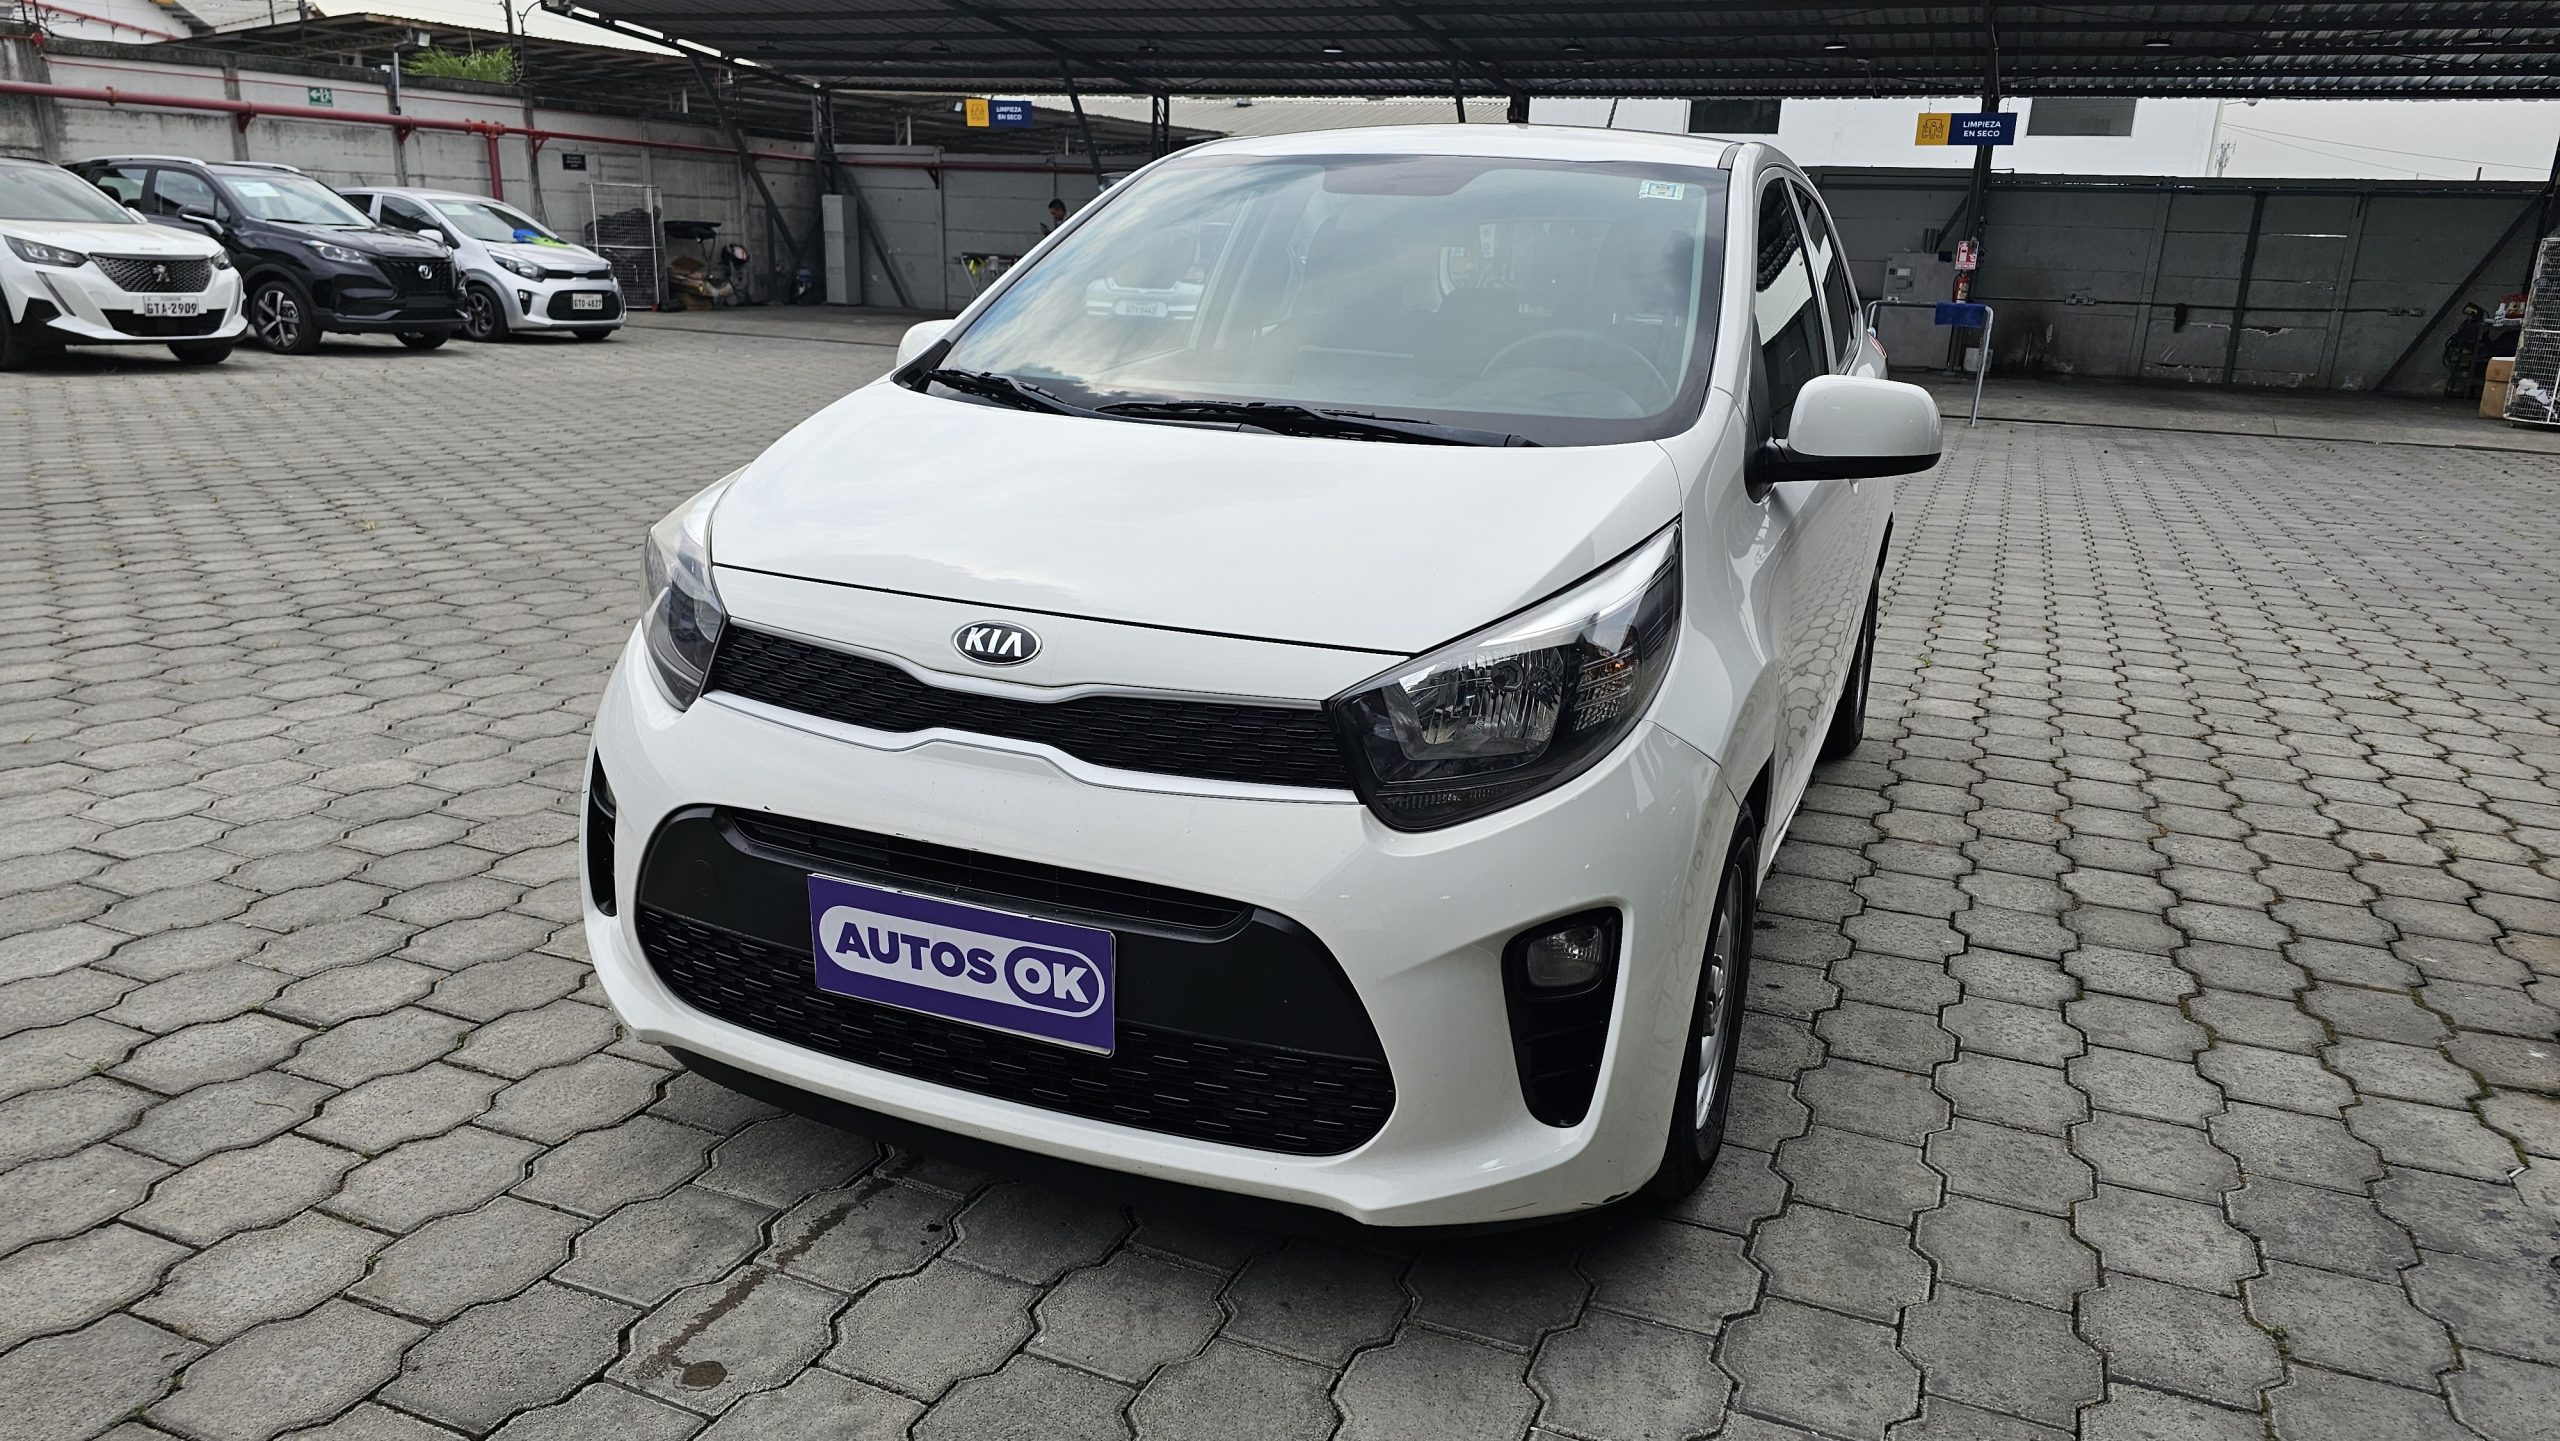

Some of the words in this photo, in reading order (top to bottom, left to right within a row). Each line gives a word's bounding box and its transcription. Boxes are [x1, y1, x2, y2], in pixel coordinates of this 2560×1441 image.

[1962, 120, 2001, 128] LIMPIEZA
[146, 302, 197, 315] GTA-2909
[964, 626, 1022, 658] KIA
[835, 921, 998, 985] AUTOS
[1013, 957, 1090, 1004] OK
